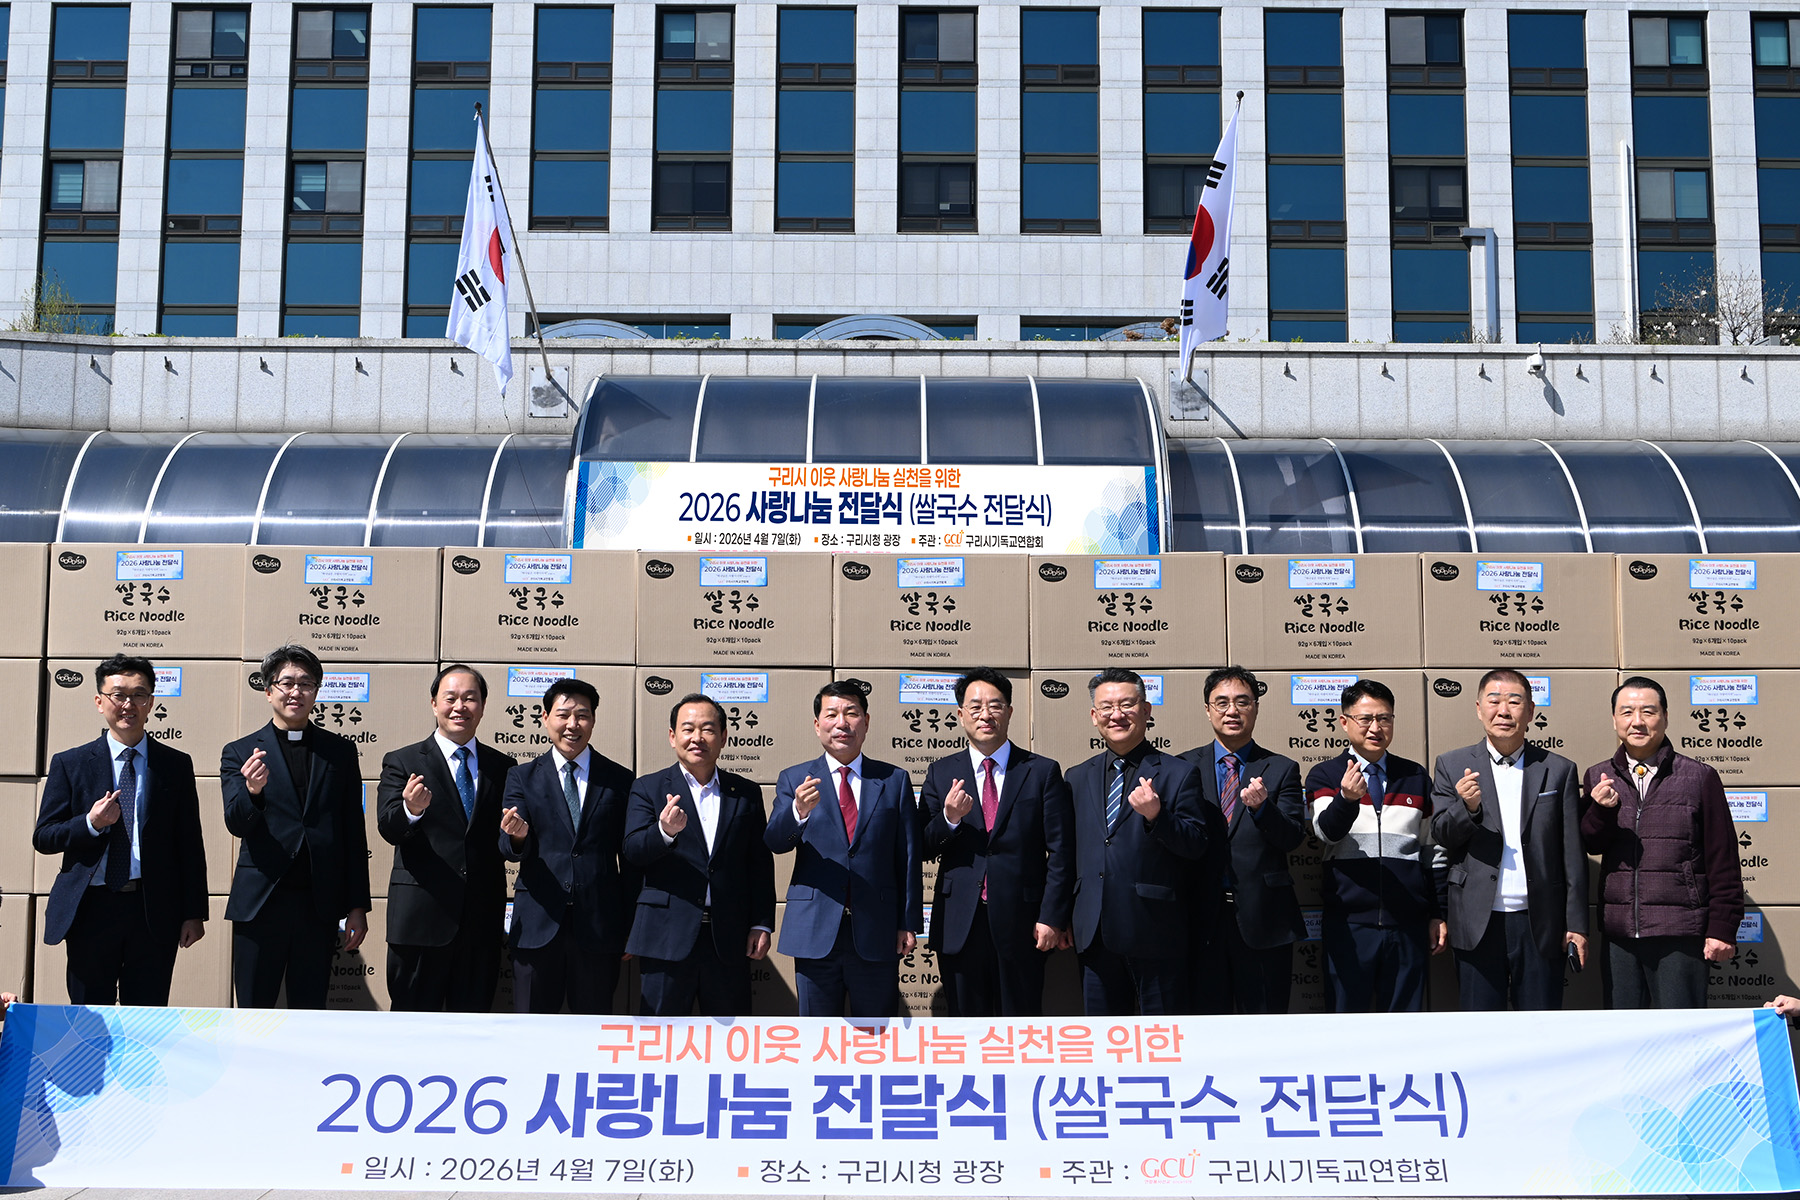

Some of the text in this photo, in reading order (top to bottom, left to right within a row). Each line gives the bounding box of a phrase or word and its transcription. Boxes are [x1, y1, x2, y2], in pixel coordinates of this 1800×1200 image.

[769, 467, 961, 488] 구리시 이웃 사랑나눔 실천을 위한
[679, 491, 1051, 527] 2026 사랑나눔 전달식 (쌀국수 전달식)
[695, 532, 711, 544] 일시
[719, 533, 751, 545] 2026년
[754, 533, 768, 545] 4월
[772, 533, 801, 546] 7일(화)
[822, 534, 838, 546] 장소
[846, 534, 880, 546] 구리시청
[883, 534, 901, 547] 광장
[919, 535, 936, 547] 주관
[944, 532, 963, 545] GCU
[966, 535, 1043, 548] 구리시기독교연합회
[104, 610, 185, 623] Rice Noodle
[298, 614, 381, 626] Rice Noodle
[498, 614, 579, 627] Rice Noodle
[693, 618, 775, 631] Rice Noodle
[890, 620, 972, 632] Rice Noodle
[1087, 620, 1169, 633] Rice Noodle
[1284, 621, 1366, 634] Rice Noodle
[1479, 620, 1561, 633] Rice Noodle
[1678, 618, 1760, 631] Rice Noodle
[494, 732, 526, 744] Rice
[728, 735, 774, 747] Noodle
[892, 737, 923, 749] Rice
[1289, 737, 1320, 749] Rice
[1681, 736, 1763, 748] Rice Noodle
[1728, 974, 1775, 986] Noodle
[598, 1024, 1184, 1064] 구리시 이웃 사랑나눔 실천을 위한
[317, 1071, 1468, 1140] 2026 사랑나눔 전달식 (쌀국수 전달식)
[365, 1157, 415, 1180] 일시
[440, 1158, 539, 1181] 2026년
[550, 1159, 593, 1181] 4월
[605, 1159, 694, 1183] 7일(화)
[761, 1160, 810, 1183] 장소
[838, 1160, 940, 1184] 구리시청
[953, 1160, 1004, 1184] 광장
[1063, 1160, 1114, 1184] 주관
[1140, 1149, 1200, 1179] GCU
[1209, 1158, 1448, 1184] 구리시기독교연합회
